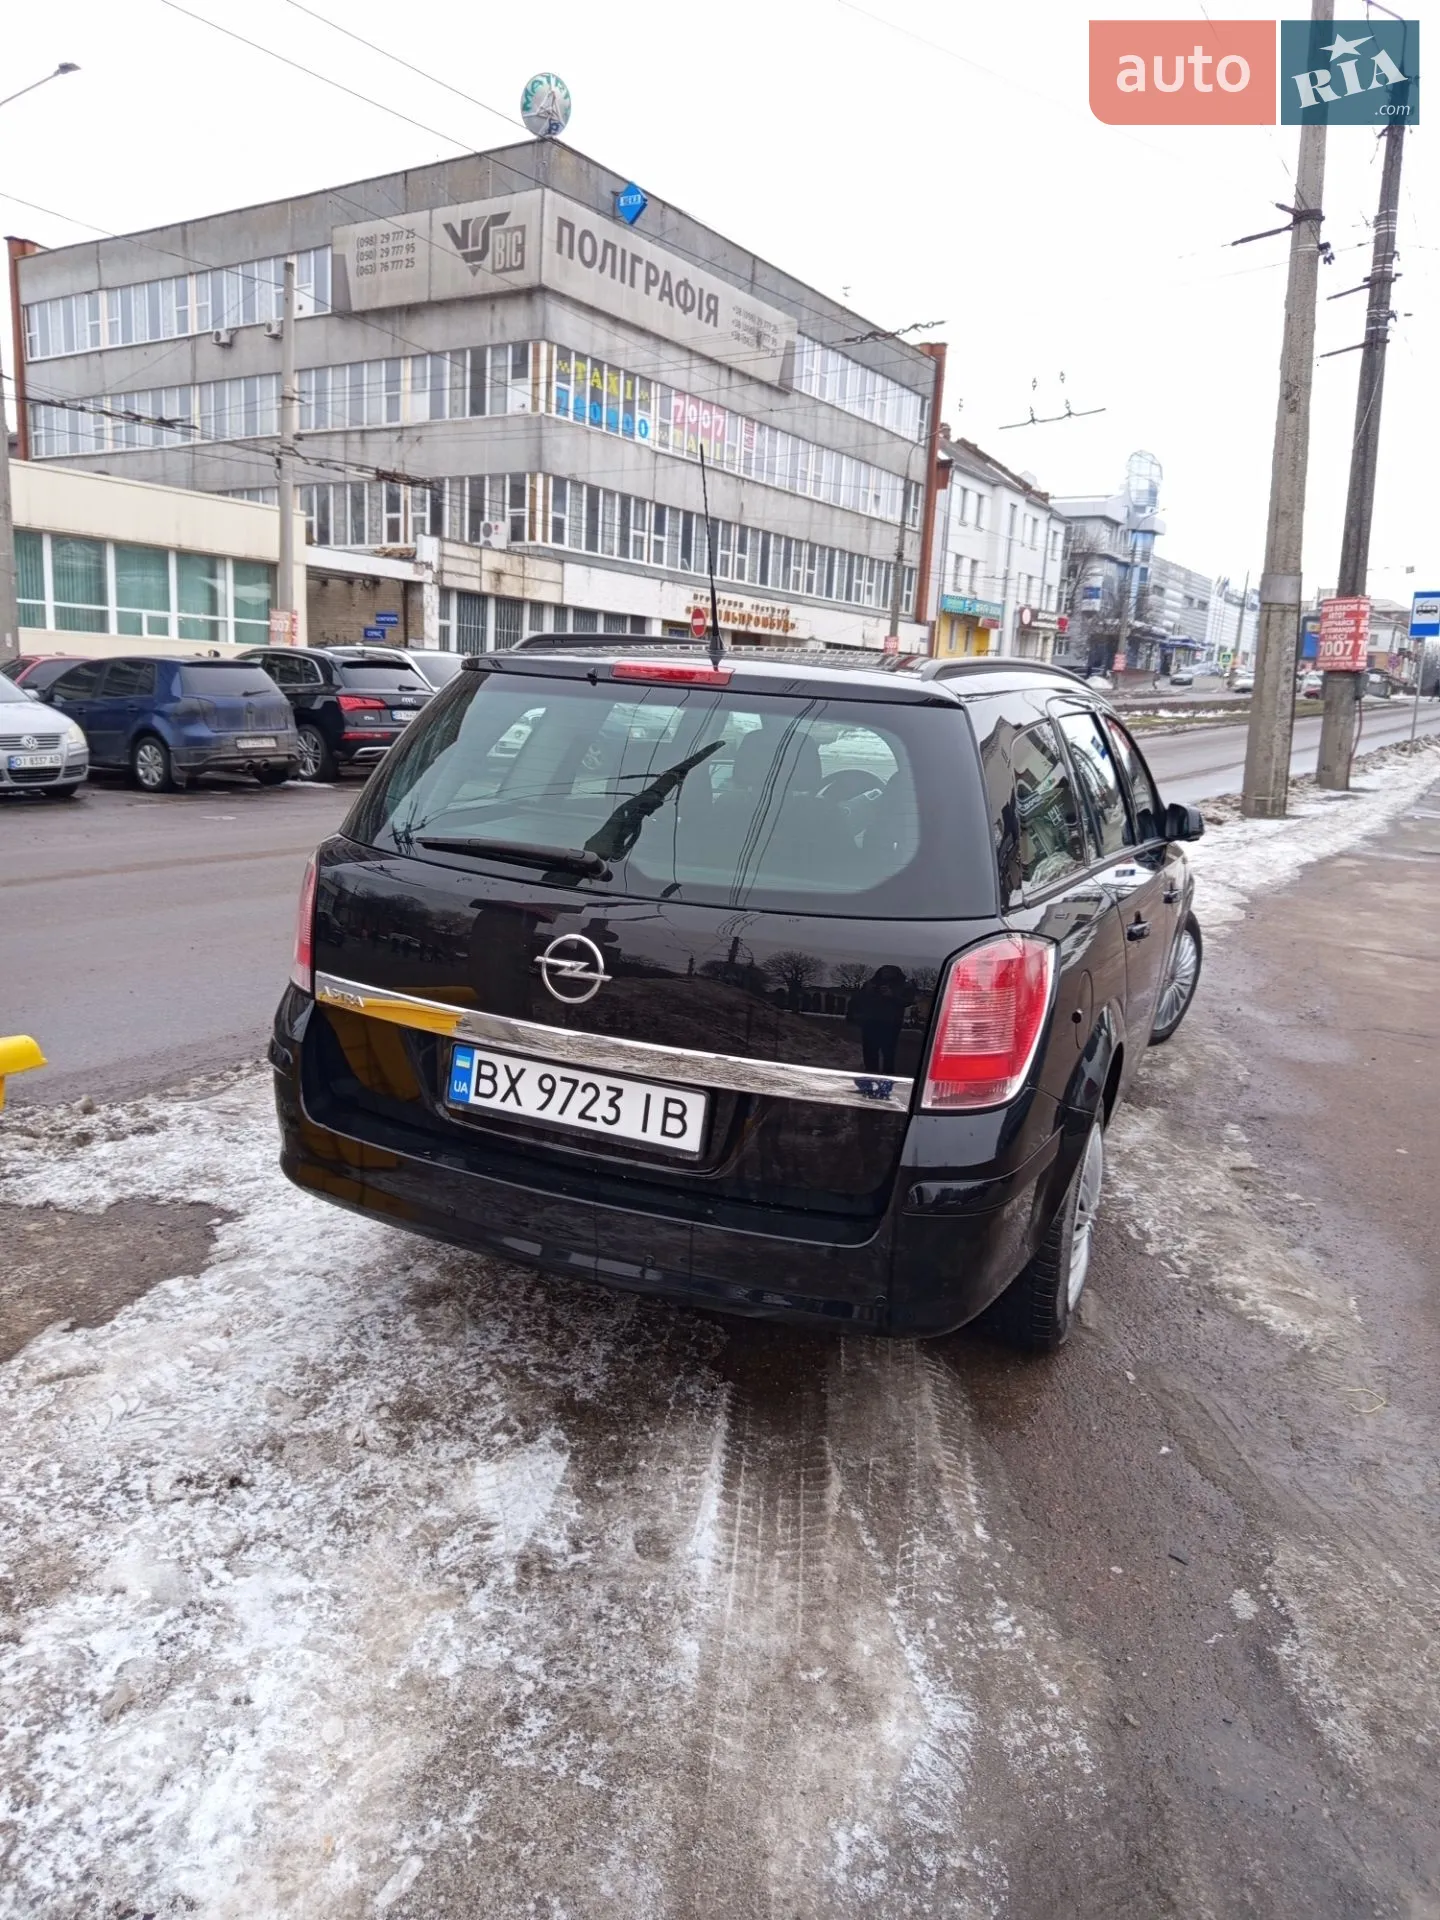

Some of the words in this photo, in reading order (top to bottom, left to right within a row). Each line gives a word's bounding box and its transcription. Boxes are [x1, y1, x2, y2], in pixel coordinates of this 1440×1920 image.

[556, 216, 719, 328] ПОЛІГРАФІЯ
[575, 360, 633, 400] TAXI
[674, 398, 725, 438] 7007
[1319, 640, 1354, 656] 7007
[454, 1081, 468, 1095] UA
[474, 1059, 526, 1107] BX
[536, 1073, 624, 1126] 9723
[641, 1093, 688, 1139] IB
